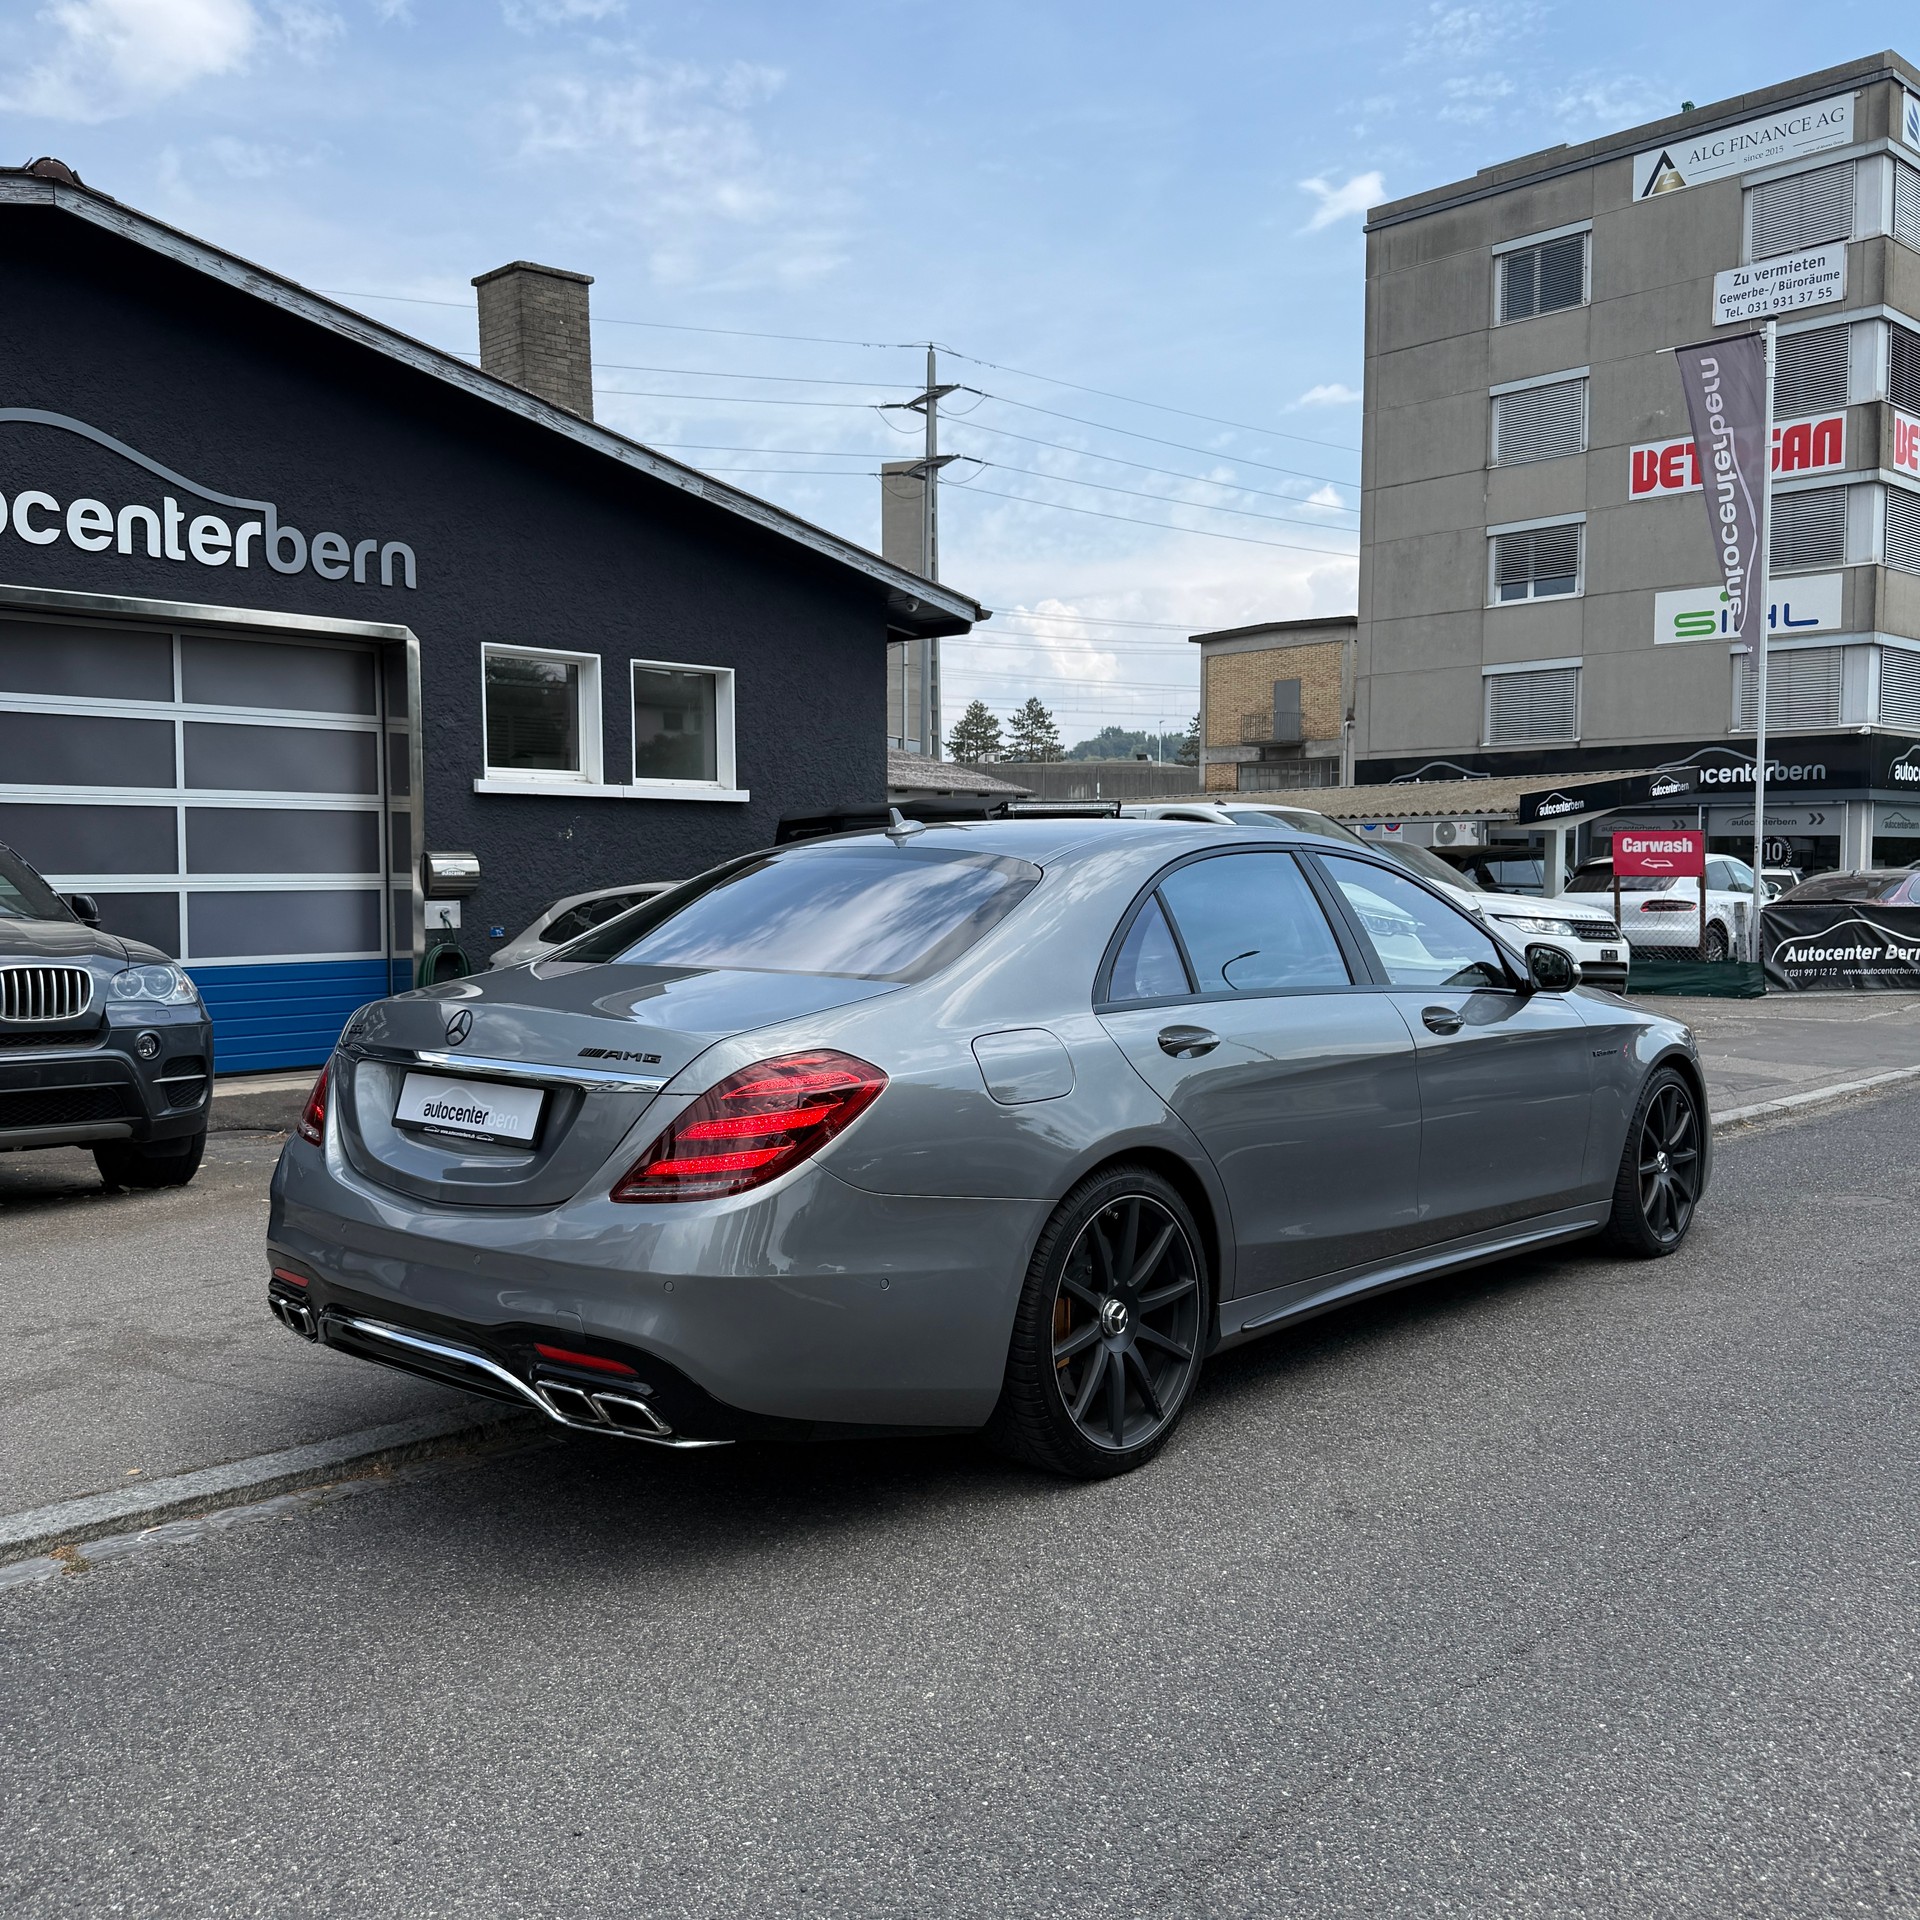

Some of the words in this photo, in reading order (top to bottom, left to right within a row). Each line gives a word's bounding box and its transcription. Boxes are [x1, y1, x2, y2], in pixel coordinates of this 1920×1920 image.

[1688, 142, 1725, 165] ALG
[1729, 116, 1812, 152] FINANCE
[1816, 107, 1845, 128] AG
[1743, 151, 1764, 163] since
[1765, 145, 1784, 158] 2015
[1733, 273, 1749, 287] Zu
[1754, 256, 1826, 281] vermieten
[1778, 271, 1840, 291] Büroräume
[1725, 308, 1743, 319] Tel.
[1747, 300, 1768, 314] 031
[1773, 295, 1794, 309] 931
[1798, 290, 1813, 303] 37
[1817, 286, 1833, 299] 55
[1896, 418, 1920, 471] BE
[1632, 417, 1842, 494] BETAN
[0, 489, 416, 589] centerbern
[1894, 761, 1920, 782] autoc
[1652, 781, 1690, 797] autocenterbern
[1539, 799, 1585, 817] autocenterbern
[1622, 837, 1693, 853] Carwash
[1765, 842, 1782, 861] 10
[1784, 945, 1882, 963] Autocenter
[1784, 969, 1789, 977] T
[1789, 968, 1802, 977] 031
[1804, 968, 1817, 977] 991
[1820, 968, 1827, 976] 12
[1829, 967, 1837, 976] 12
[602, 1050, 662, 1064] AMG
[423, 1100, 519, 1131] autocenterbern
